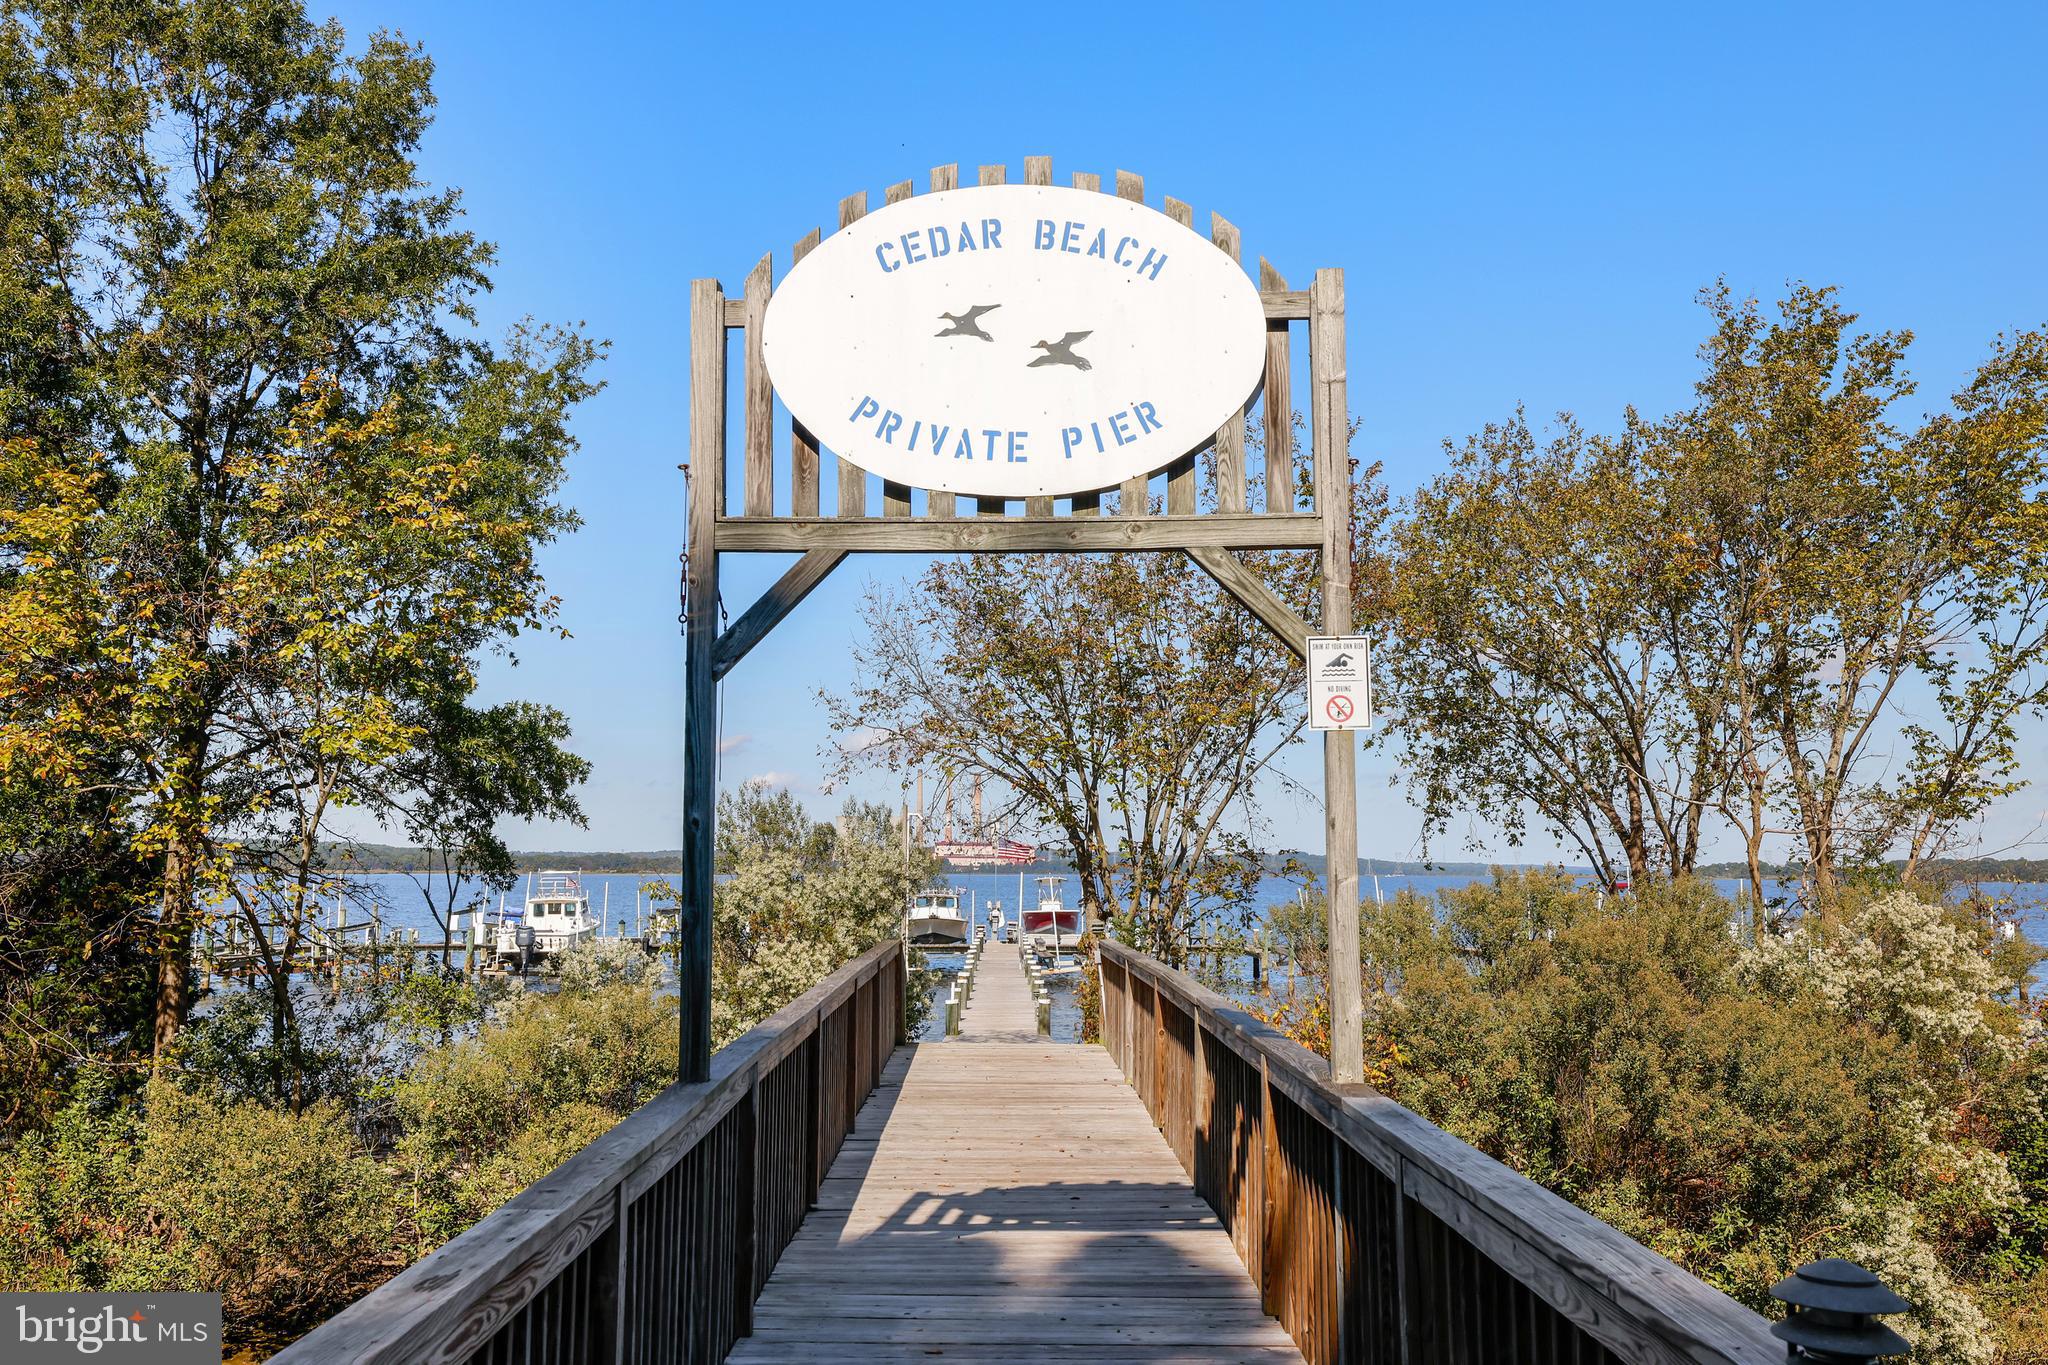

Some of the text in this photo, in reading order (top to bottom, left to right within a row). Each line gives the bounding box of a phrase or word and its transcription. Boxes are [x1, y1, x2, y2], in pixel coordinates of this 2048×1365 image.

[875, 218, 1168, 281] CEDAR BEACH
[849, 396, 1163, 463] PRIVATE PIER
